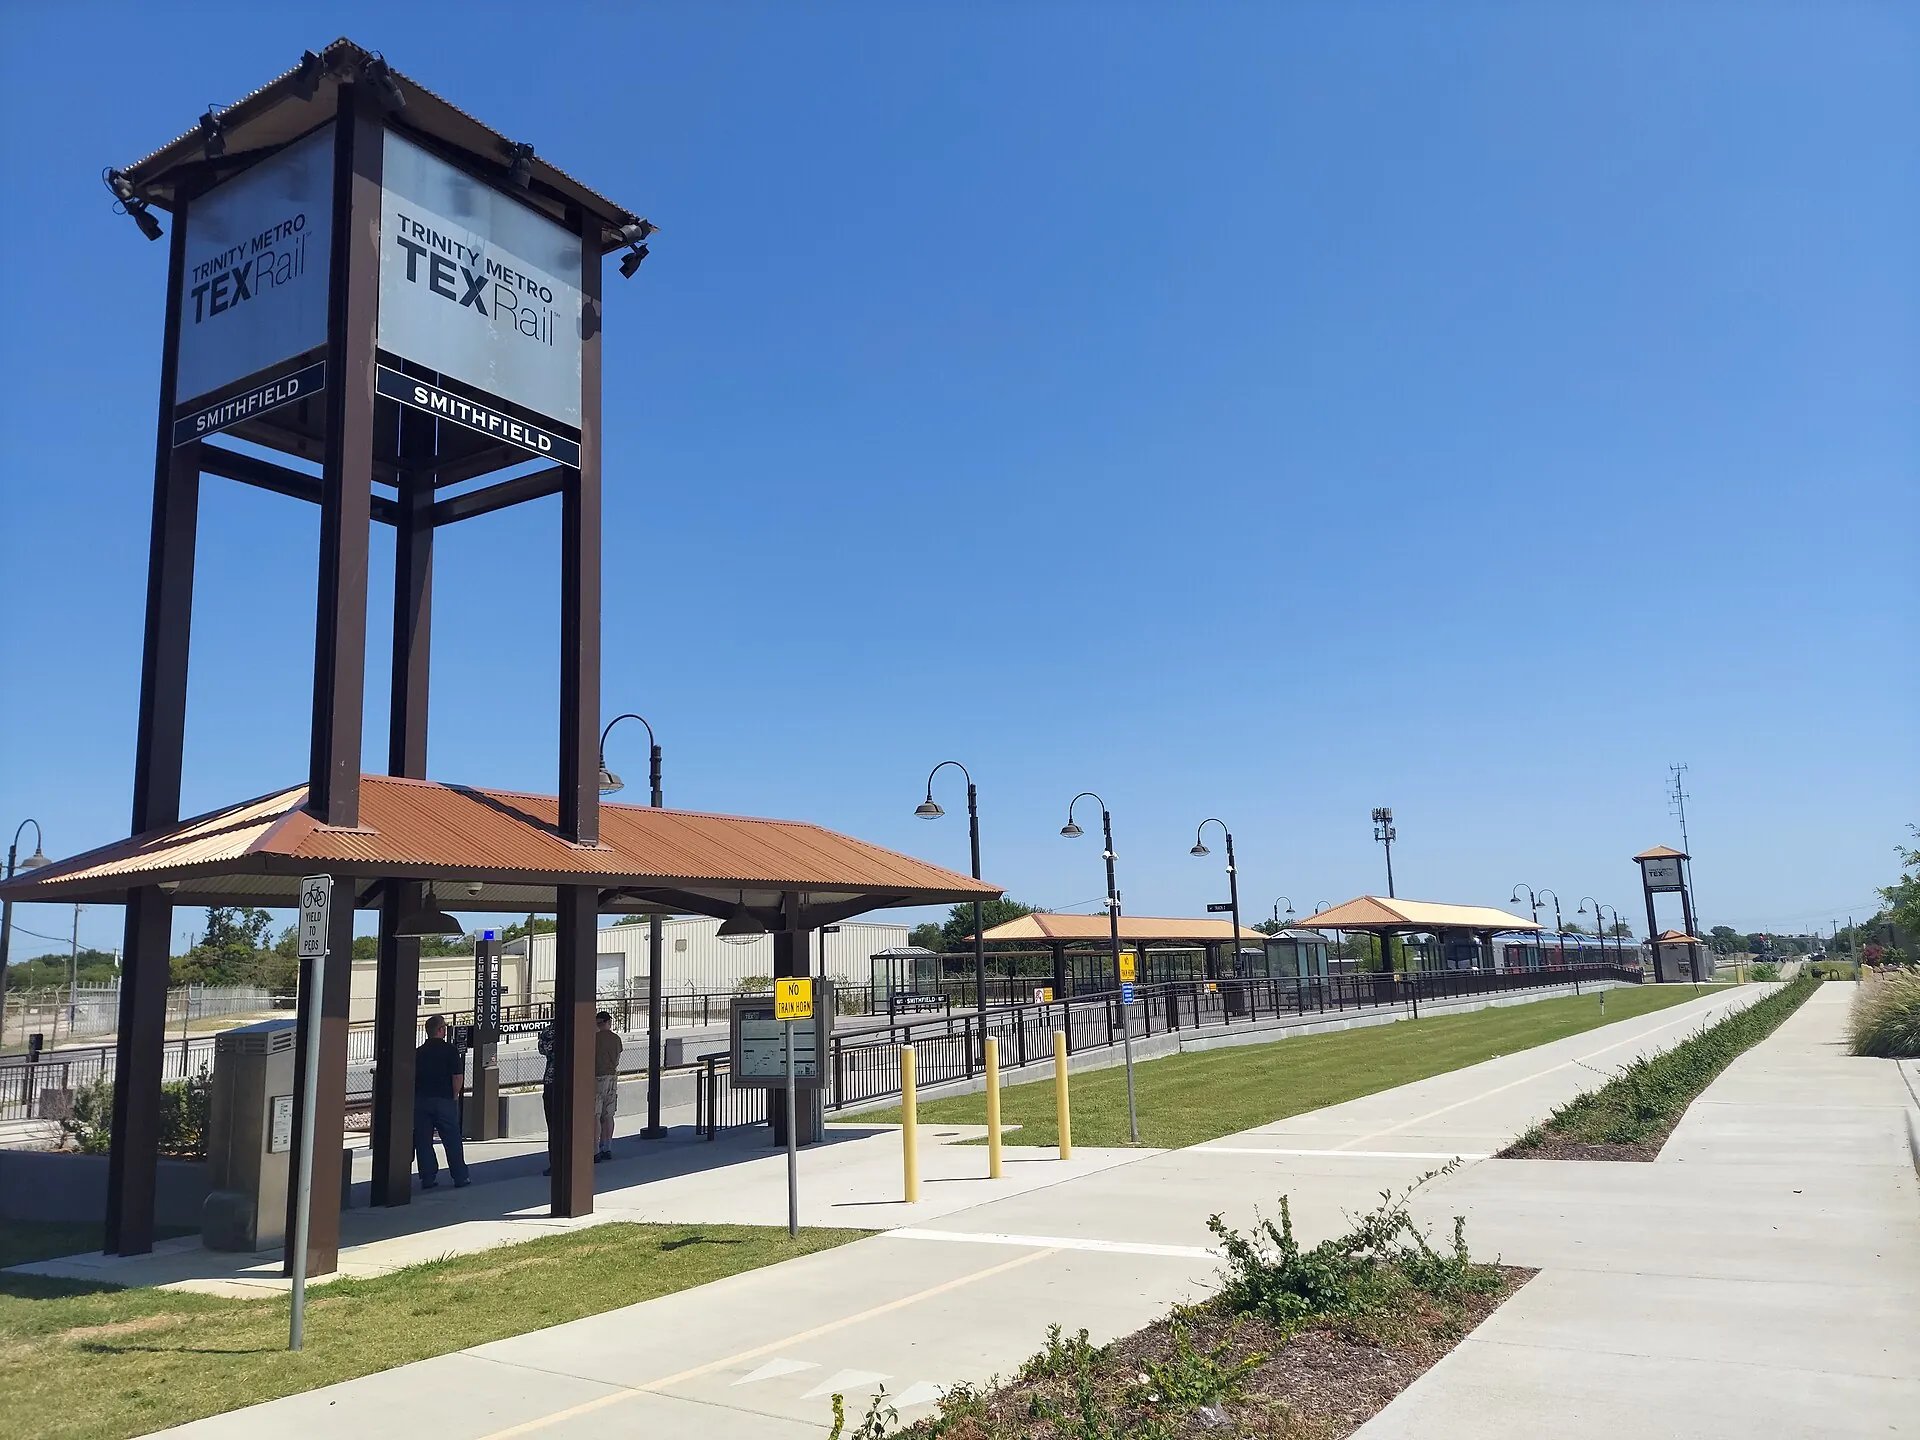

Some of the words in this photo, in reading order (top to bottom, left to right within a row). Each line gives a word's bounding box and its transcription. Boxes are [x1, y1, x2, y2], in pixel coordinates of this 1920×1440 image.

[193, 241, 247, 283] TRINITY
[251, 213, 306, 255] METRO
[397, 213, 480, 266] TRINITY
[486, 258, 553, 304] METRO
[196, 378, 299, 432] SMITHFIELD
[413, 386, 552, 451] SMITHFIELD
[305, 911, 322, 922] YIELD
[308, 925, 316, 936] TO
[304, 940, 319, 951] PEDS
[477, 956, 485, 1030] EMERGENCY
[490, 955, 499, 1029] EMERGENCY
[788, 984, 800, 995] NO
[778, 1002, 795, 1014] TRAIN
[796, 1001, 811, 1013] HORN
[520, 1021, 551, 1031] WORTH
